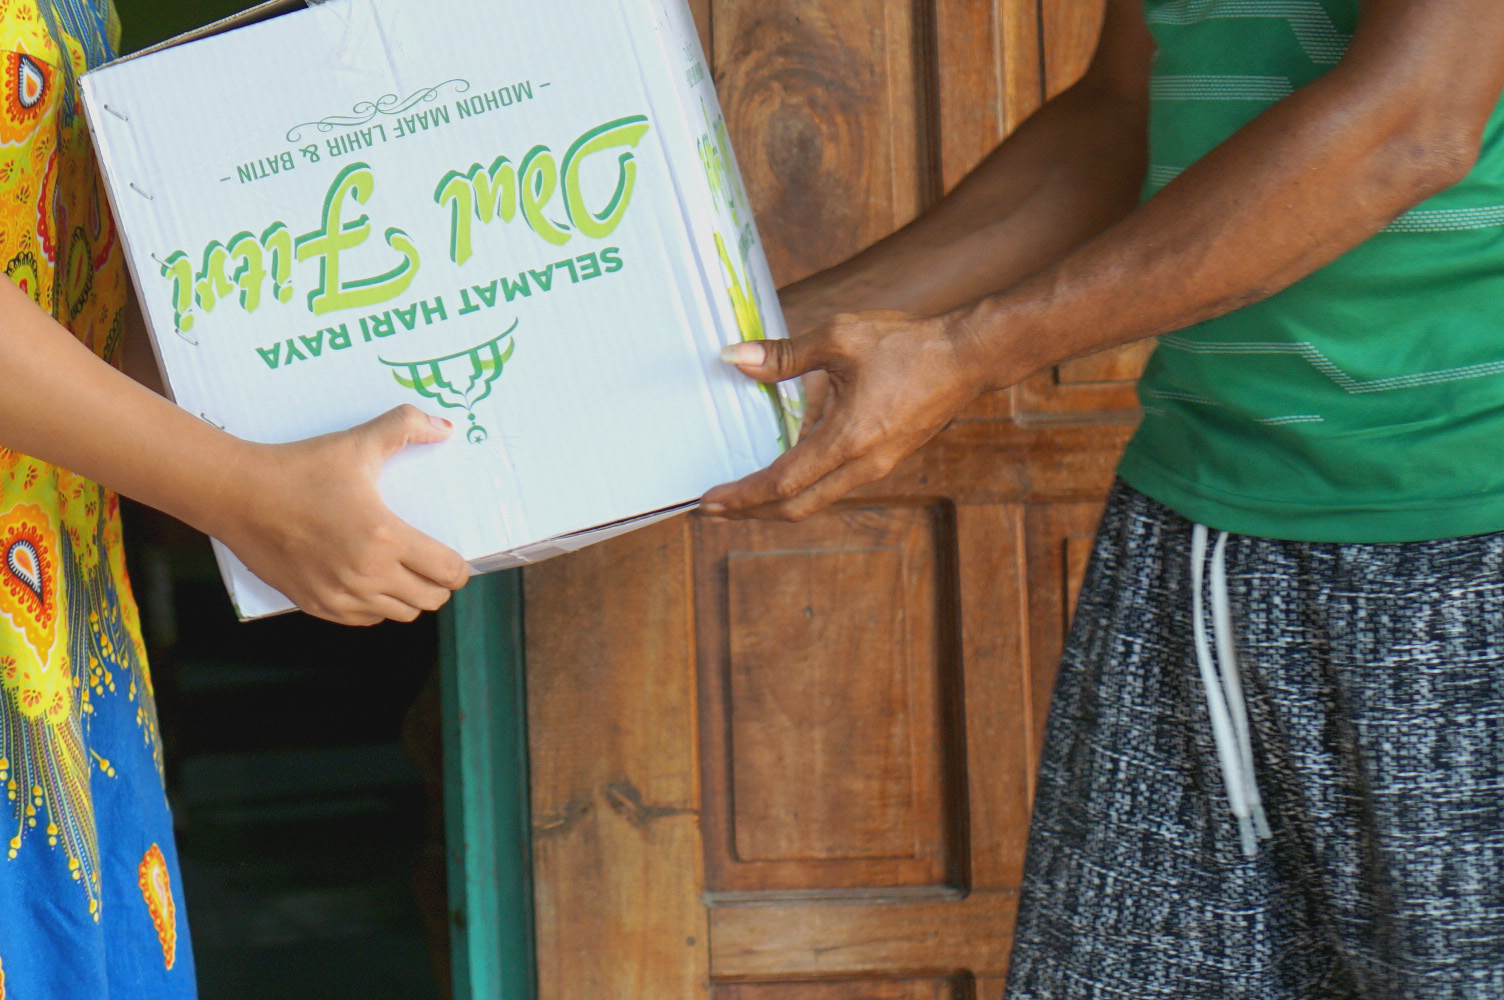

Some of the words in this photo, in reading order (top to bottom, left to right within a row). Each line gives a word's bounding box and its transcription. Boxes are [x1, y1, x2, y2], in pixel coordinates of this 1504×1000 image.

[392, 103, 450, 139] MAAF
[455, 79, 534, 120] MOHON
[298, 143, 321, 163] &
[325, 122, 387, 158] LAHIR
[235, 150, 296, 184] BATIN
[433, 113, 651, 267] Idul
[159, 160, 422, 334] Fitri
[457, 246, 624, 316] SELAMAT
[358, 295, 449, 343] HARI
[254, 323, 353, 370] RAYA
